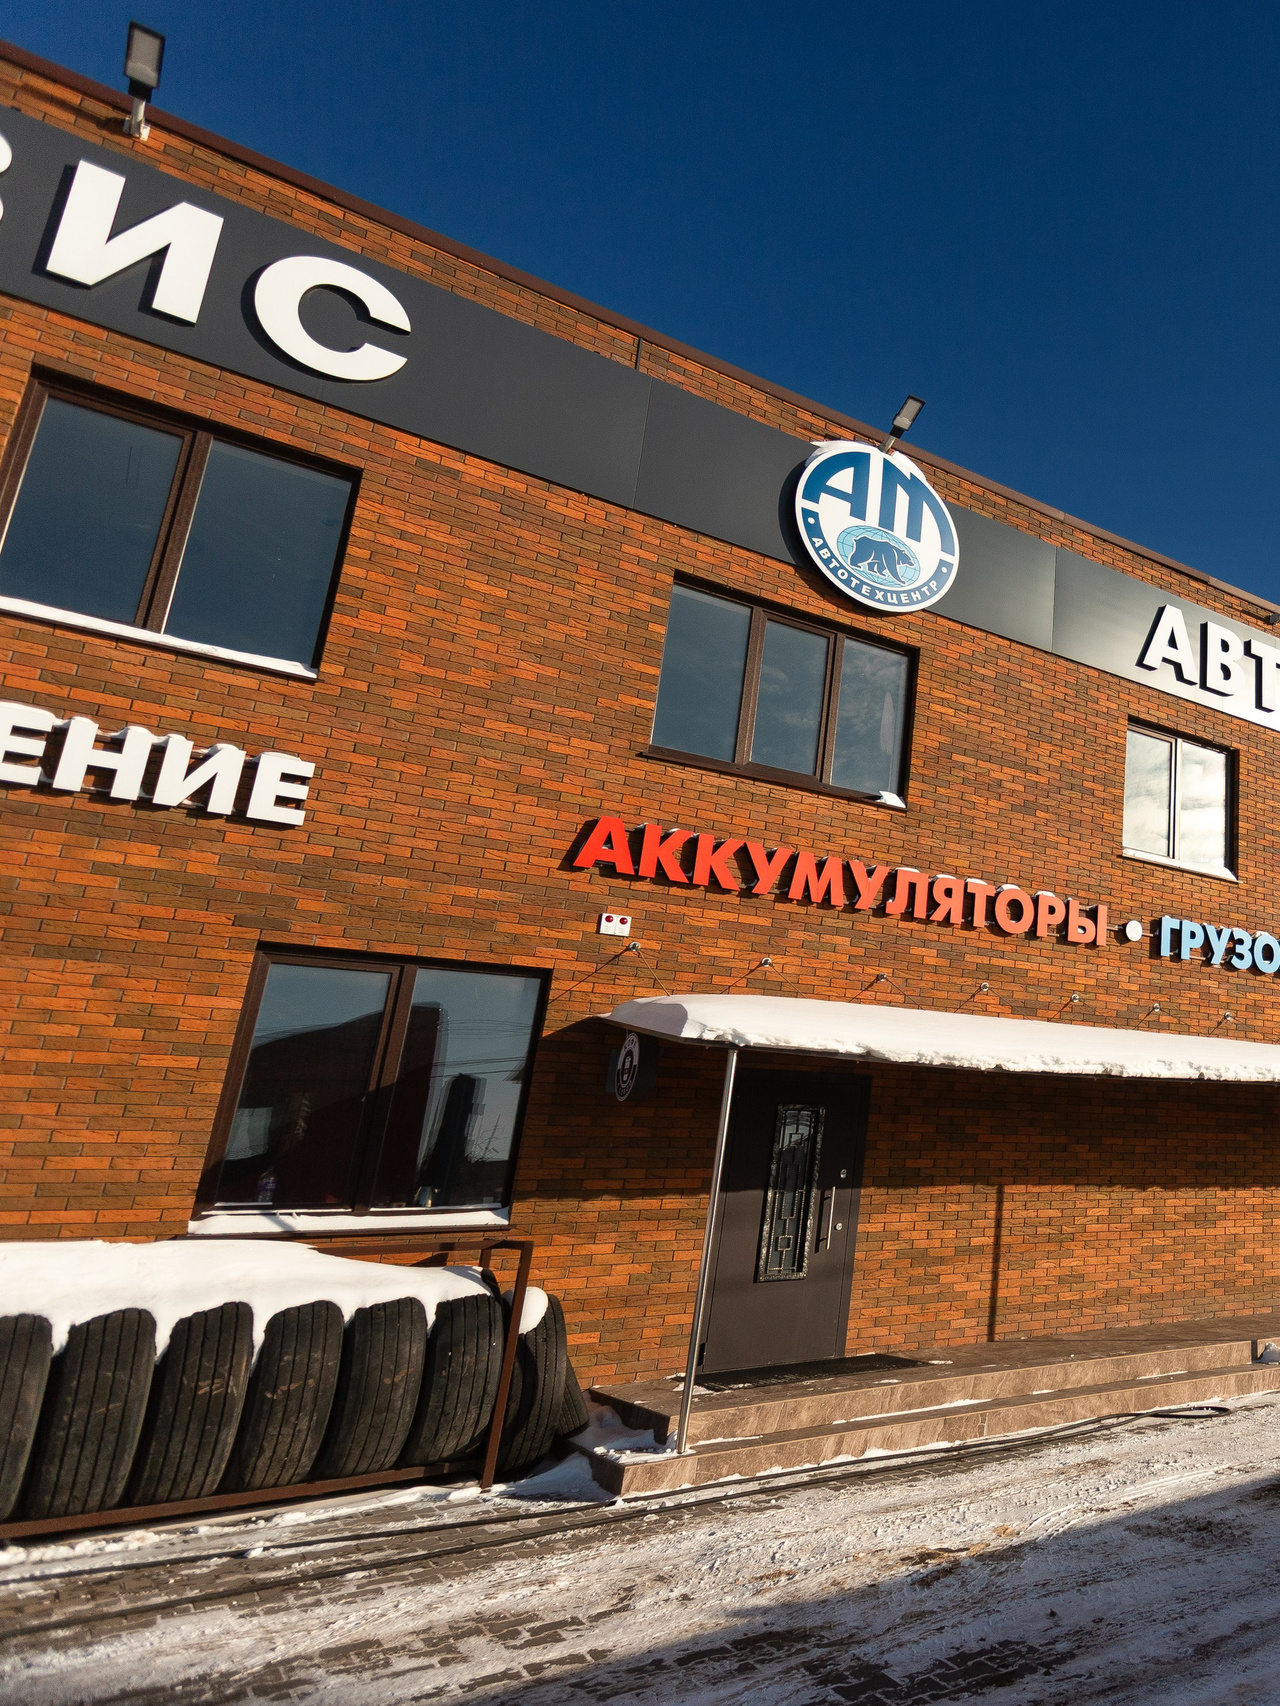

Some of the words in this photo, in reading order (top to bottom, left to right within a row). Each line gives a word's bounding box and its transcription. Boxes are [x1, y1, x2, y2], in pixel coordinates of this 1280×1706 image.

[0, 133, 412, 382] ИС
[811, 536, 938, 605] АВТОТЕХЦЕНТР
[572, 815, 1108, 947] АККУМУЛЯТОРЫ
